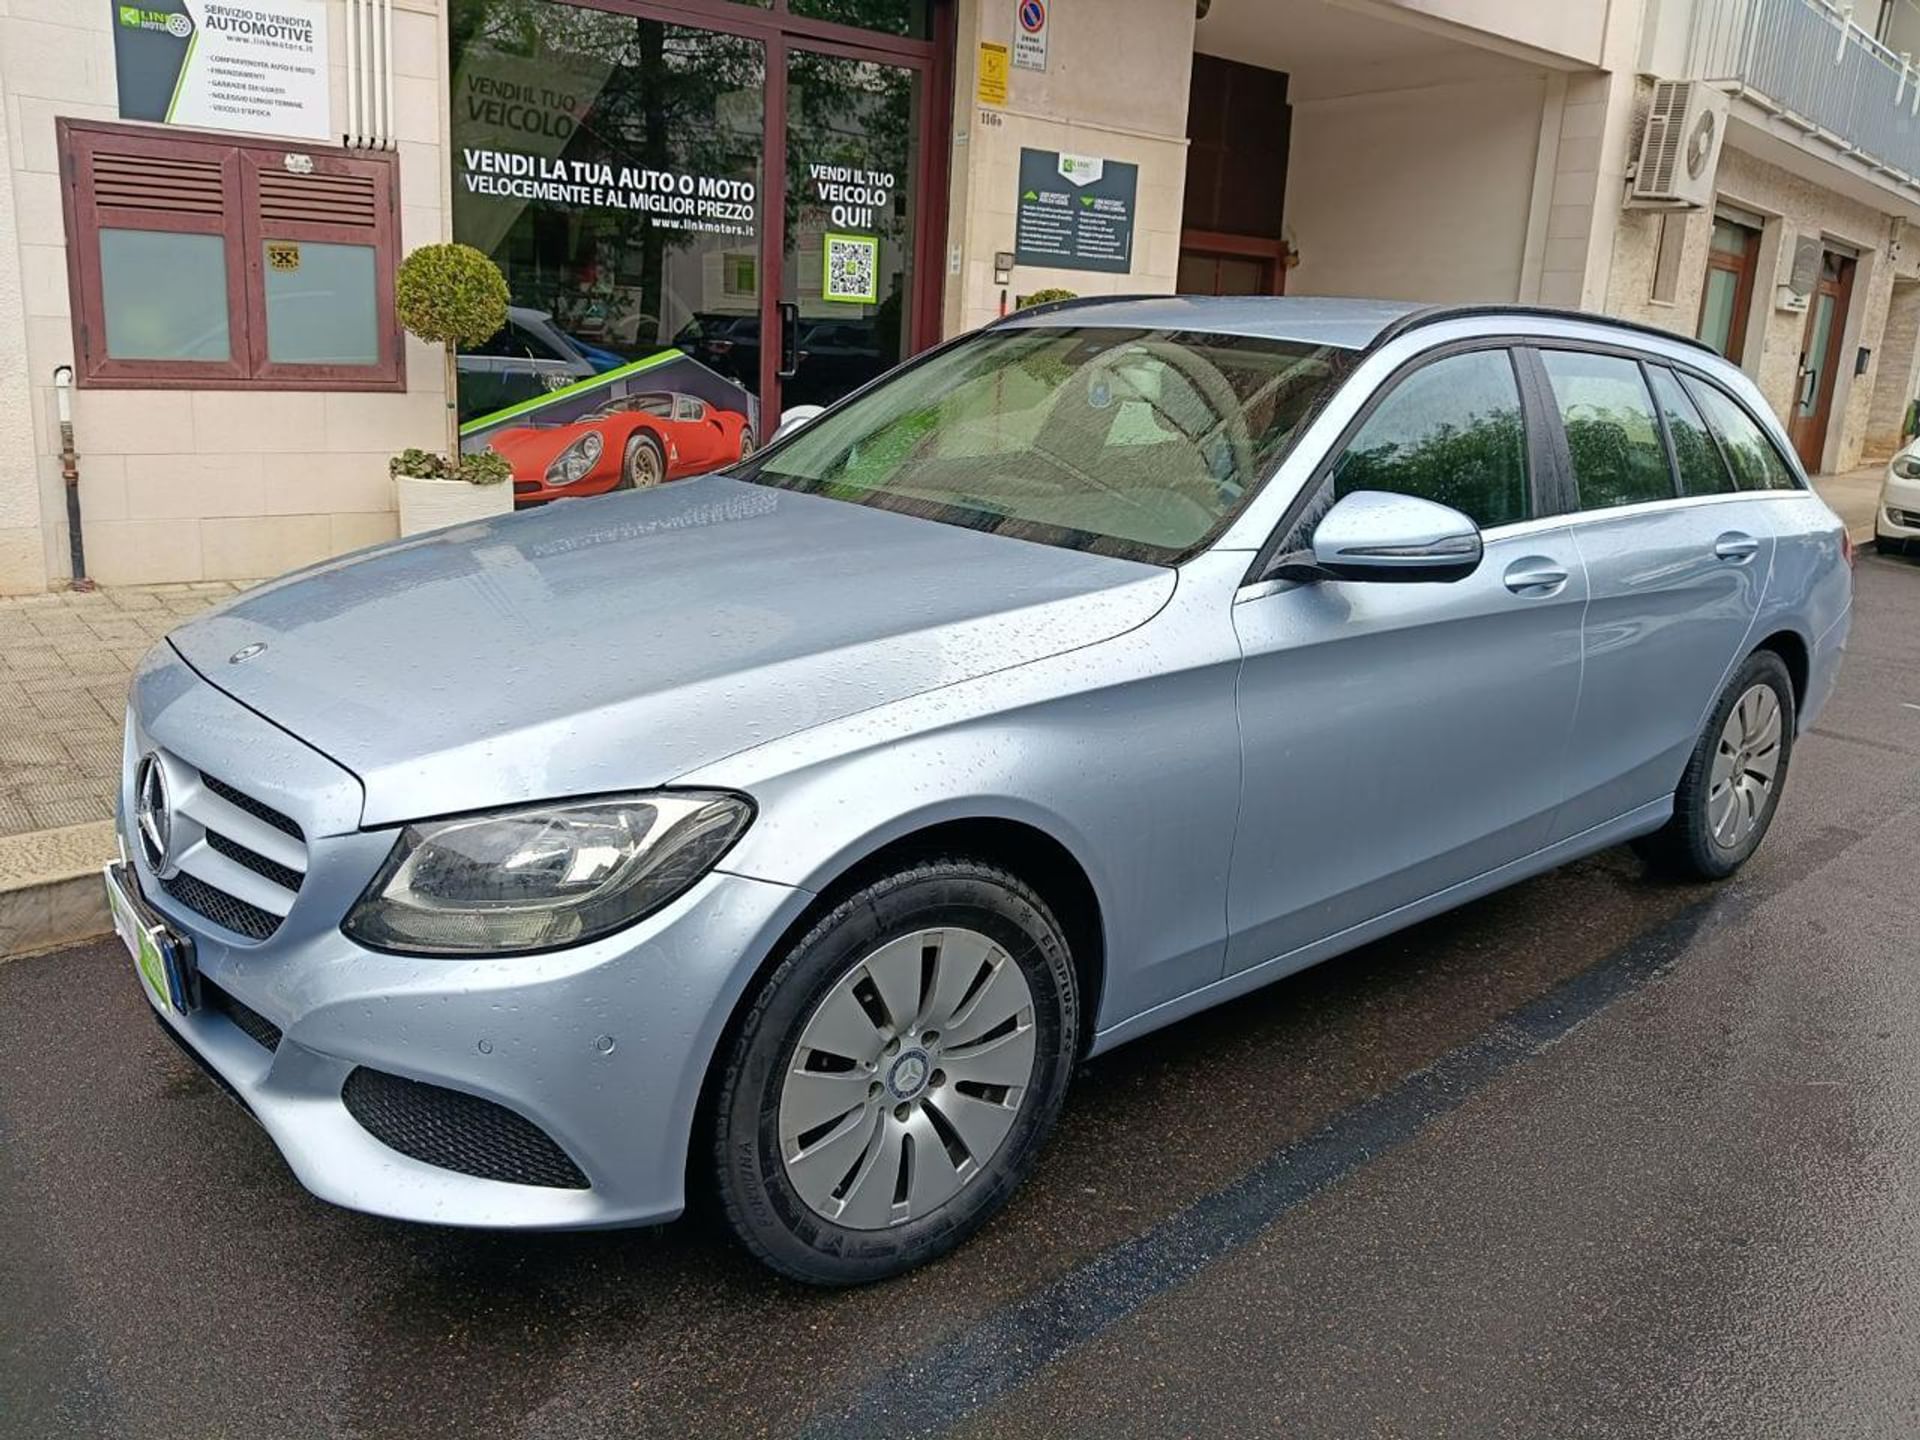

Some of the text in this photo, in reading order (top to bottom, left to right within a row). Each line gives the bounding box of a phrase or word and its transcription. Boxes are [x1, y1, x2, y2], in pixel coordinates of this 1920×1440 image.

[204, 4, 313, 28] SERVIZIO DI VENDITA
[205, 15, 313, 43] AUTOMOTIVE
[467, 75, 576, 112] VENDI IL TUO
[467, 96, 573, 140] VEICOLO
[464, 149, 755, 202] VENDI LA TUA AUTO O MOTO
[810, 163, 895, 188] VENDI IL TUO
[465, 174, 754, 221] VELOCEMENTE E AL MIGLIOR PREZZO
[818, 182, 887, 207] VEICOLO
[651, 217, 755, 237] www.linkmotors.it
[831, 204, 873, 228] QUI!
